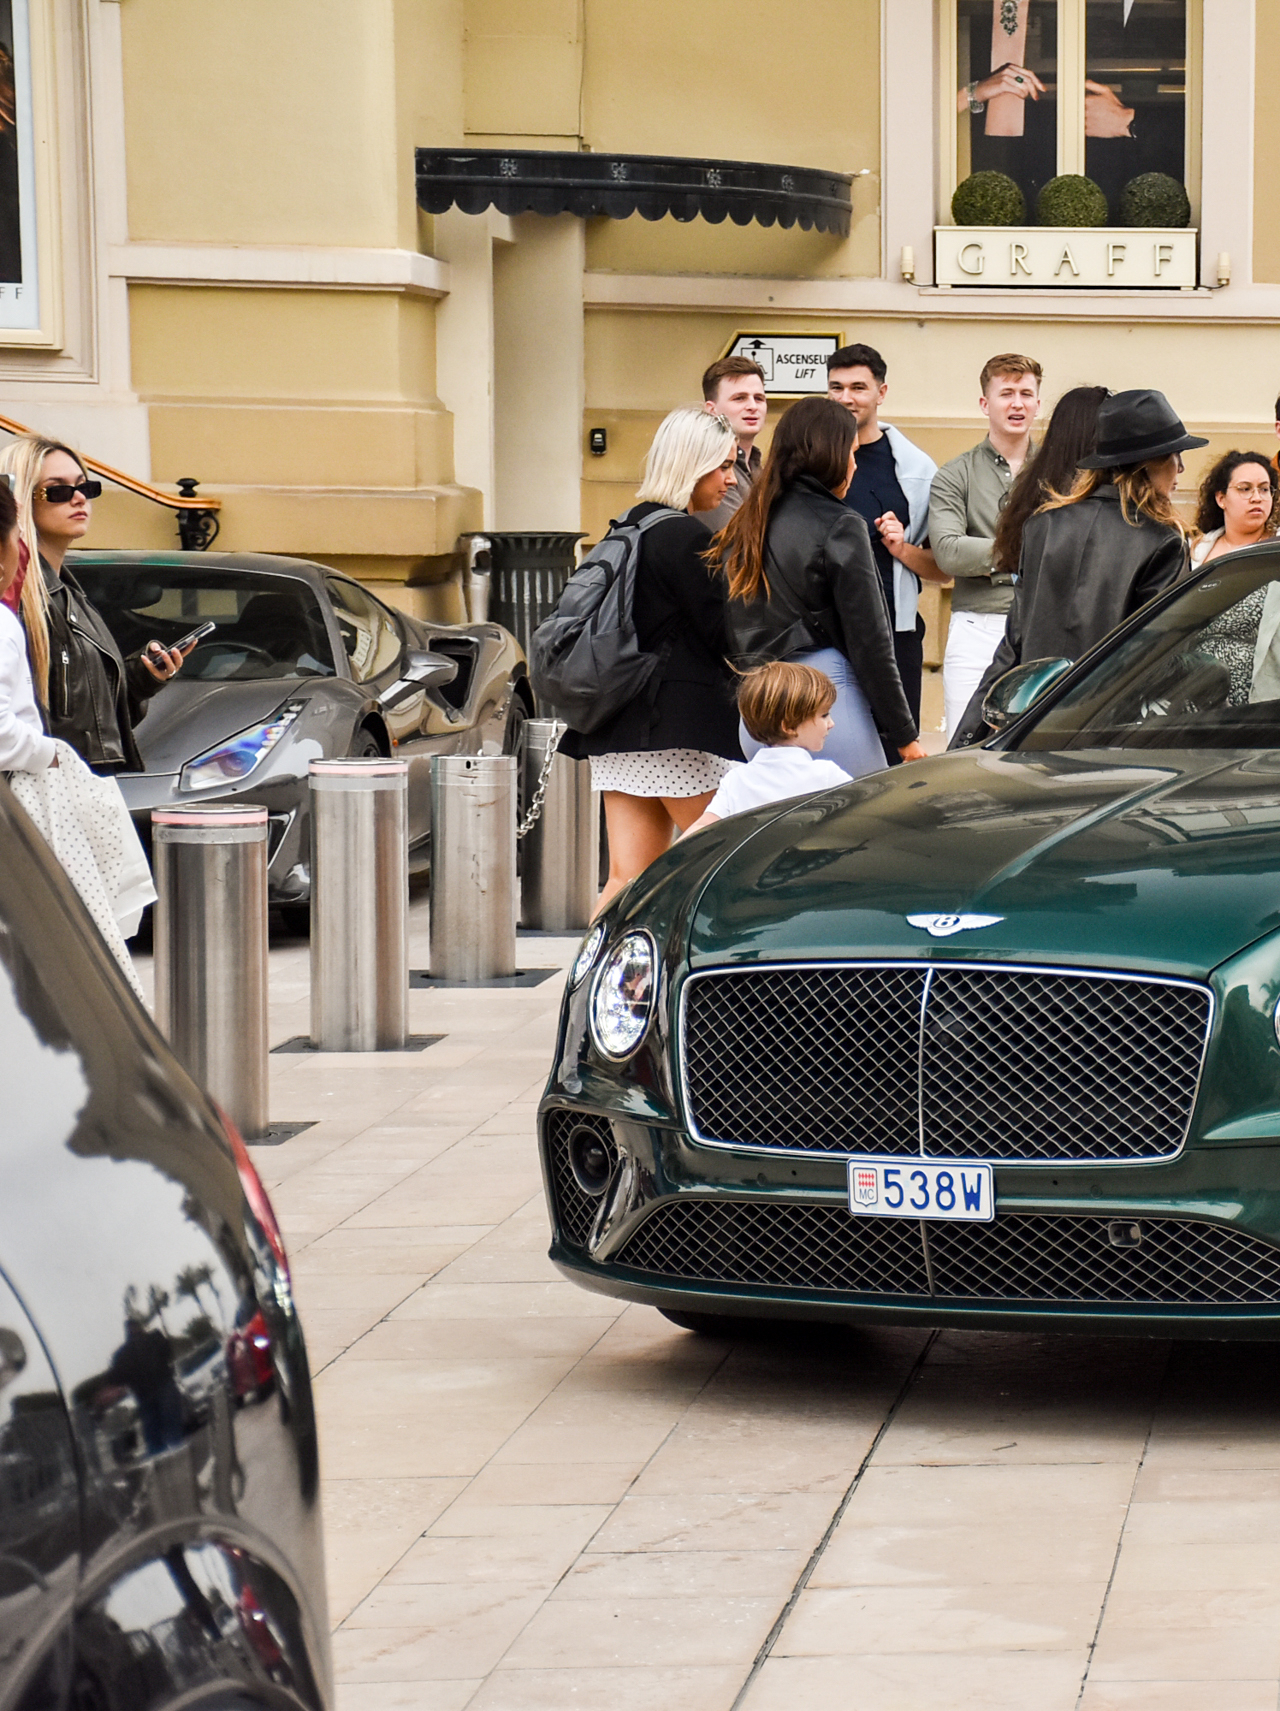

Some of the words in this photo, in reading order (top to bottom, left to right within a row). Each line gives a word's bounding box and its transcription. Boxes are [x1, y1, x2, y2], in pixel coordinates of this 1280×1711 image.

[957, 242, 1174, 276] GRAFF
[795, 368, 816, 379] LIFT
[859, 1188, 875, 1200] MC
[883, 1168, 982, 1212] 538W
